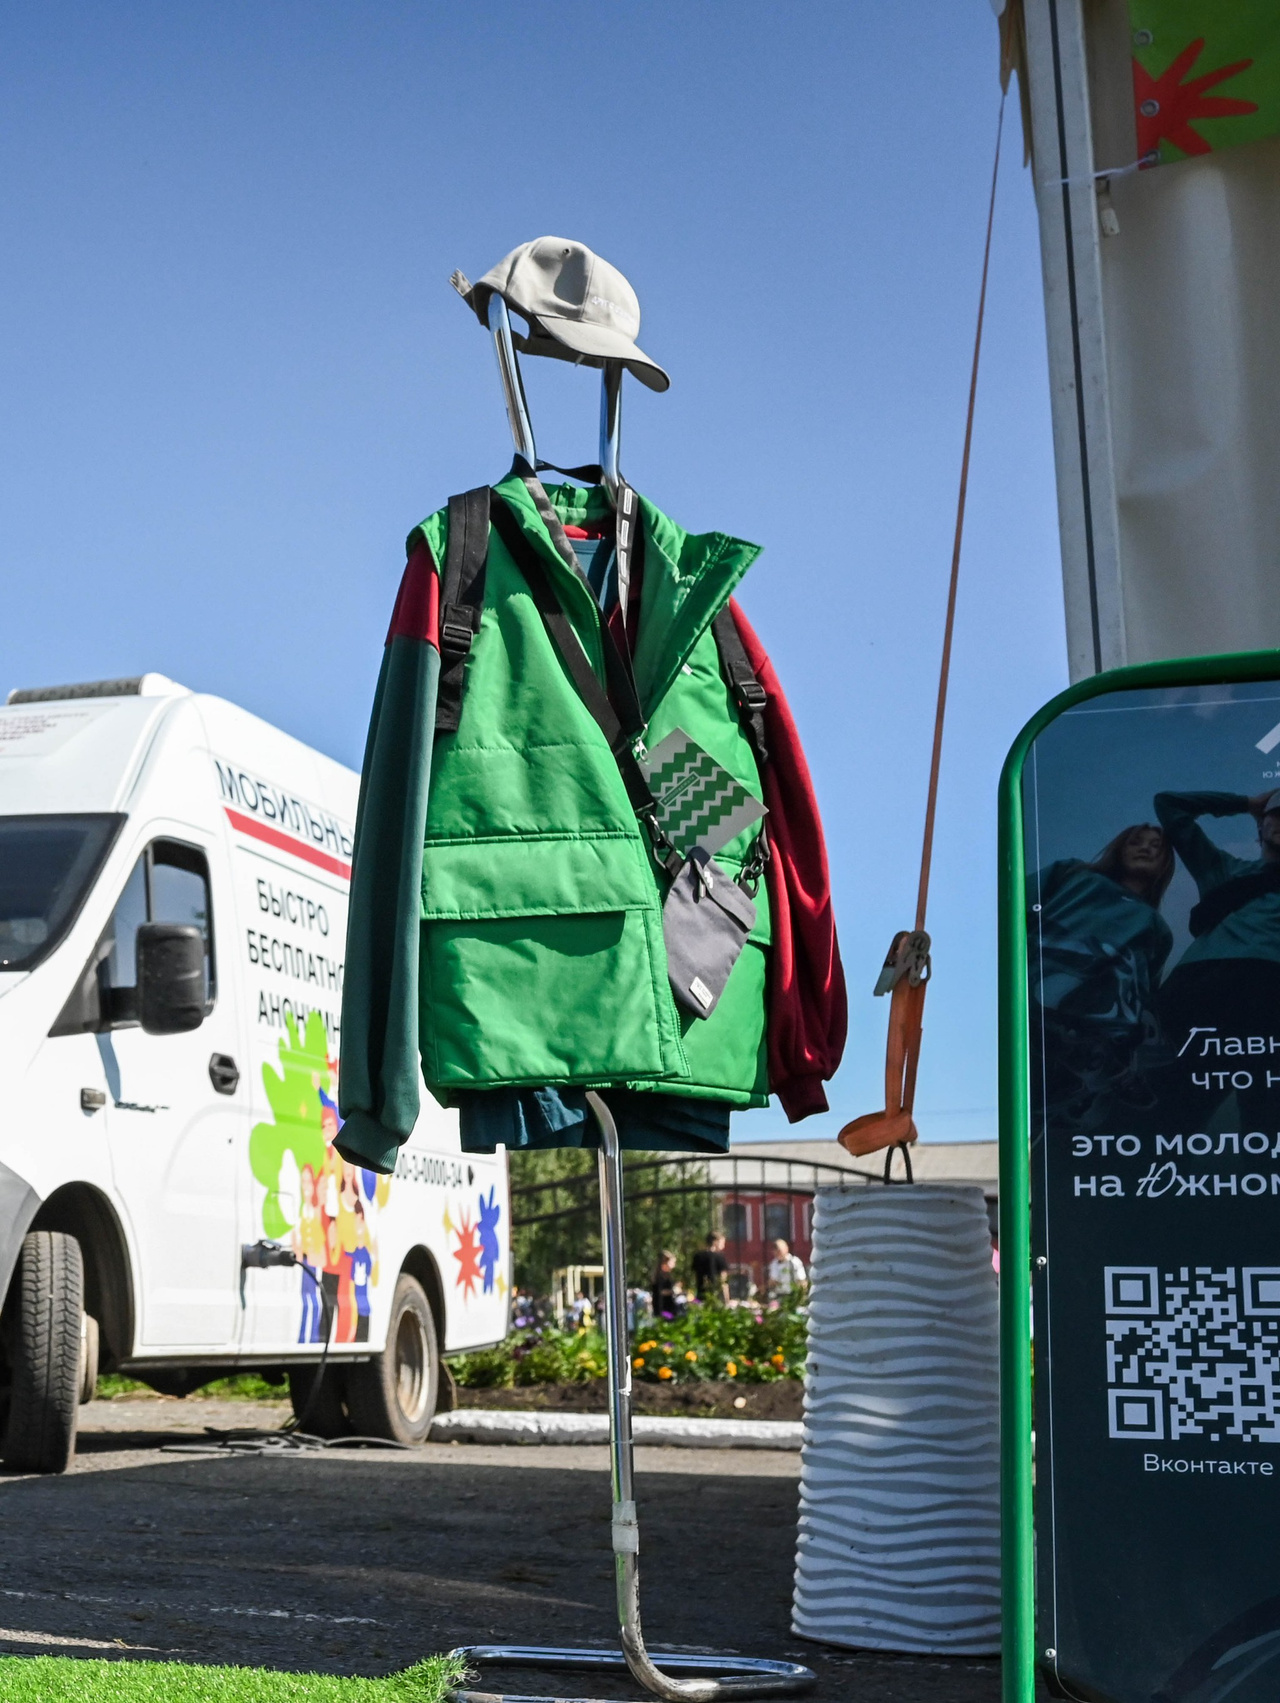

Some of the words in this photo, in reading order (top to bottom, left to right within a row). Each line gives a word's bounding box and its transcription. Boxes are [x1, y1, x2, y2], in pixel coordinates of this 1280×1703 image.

[256, 878, 330, 936] БЫСТРО
[1191, 1070, 1253, 1090] что
[1071, 1134, 1141, 1157] это
[1074, 1174, 1125, 1197] на
[1143, 1453, 1274, 1476] Вконтакте
